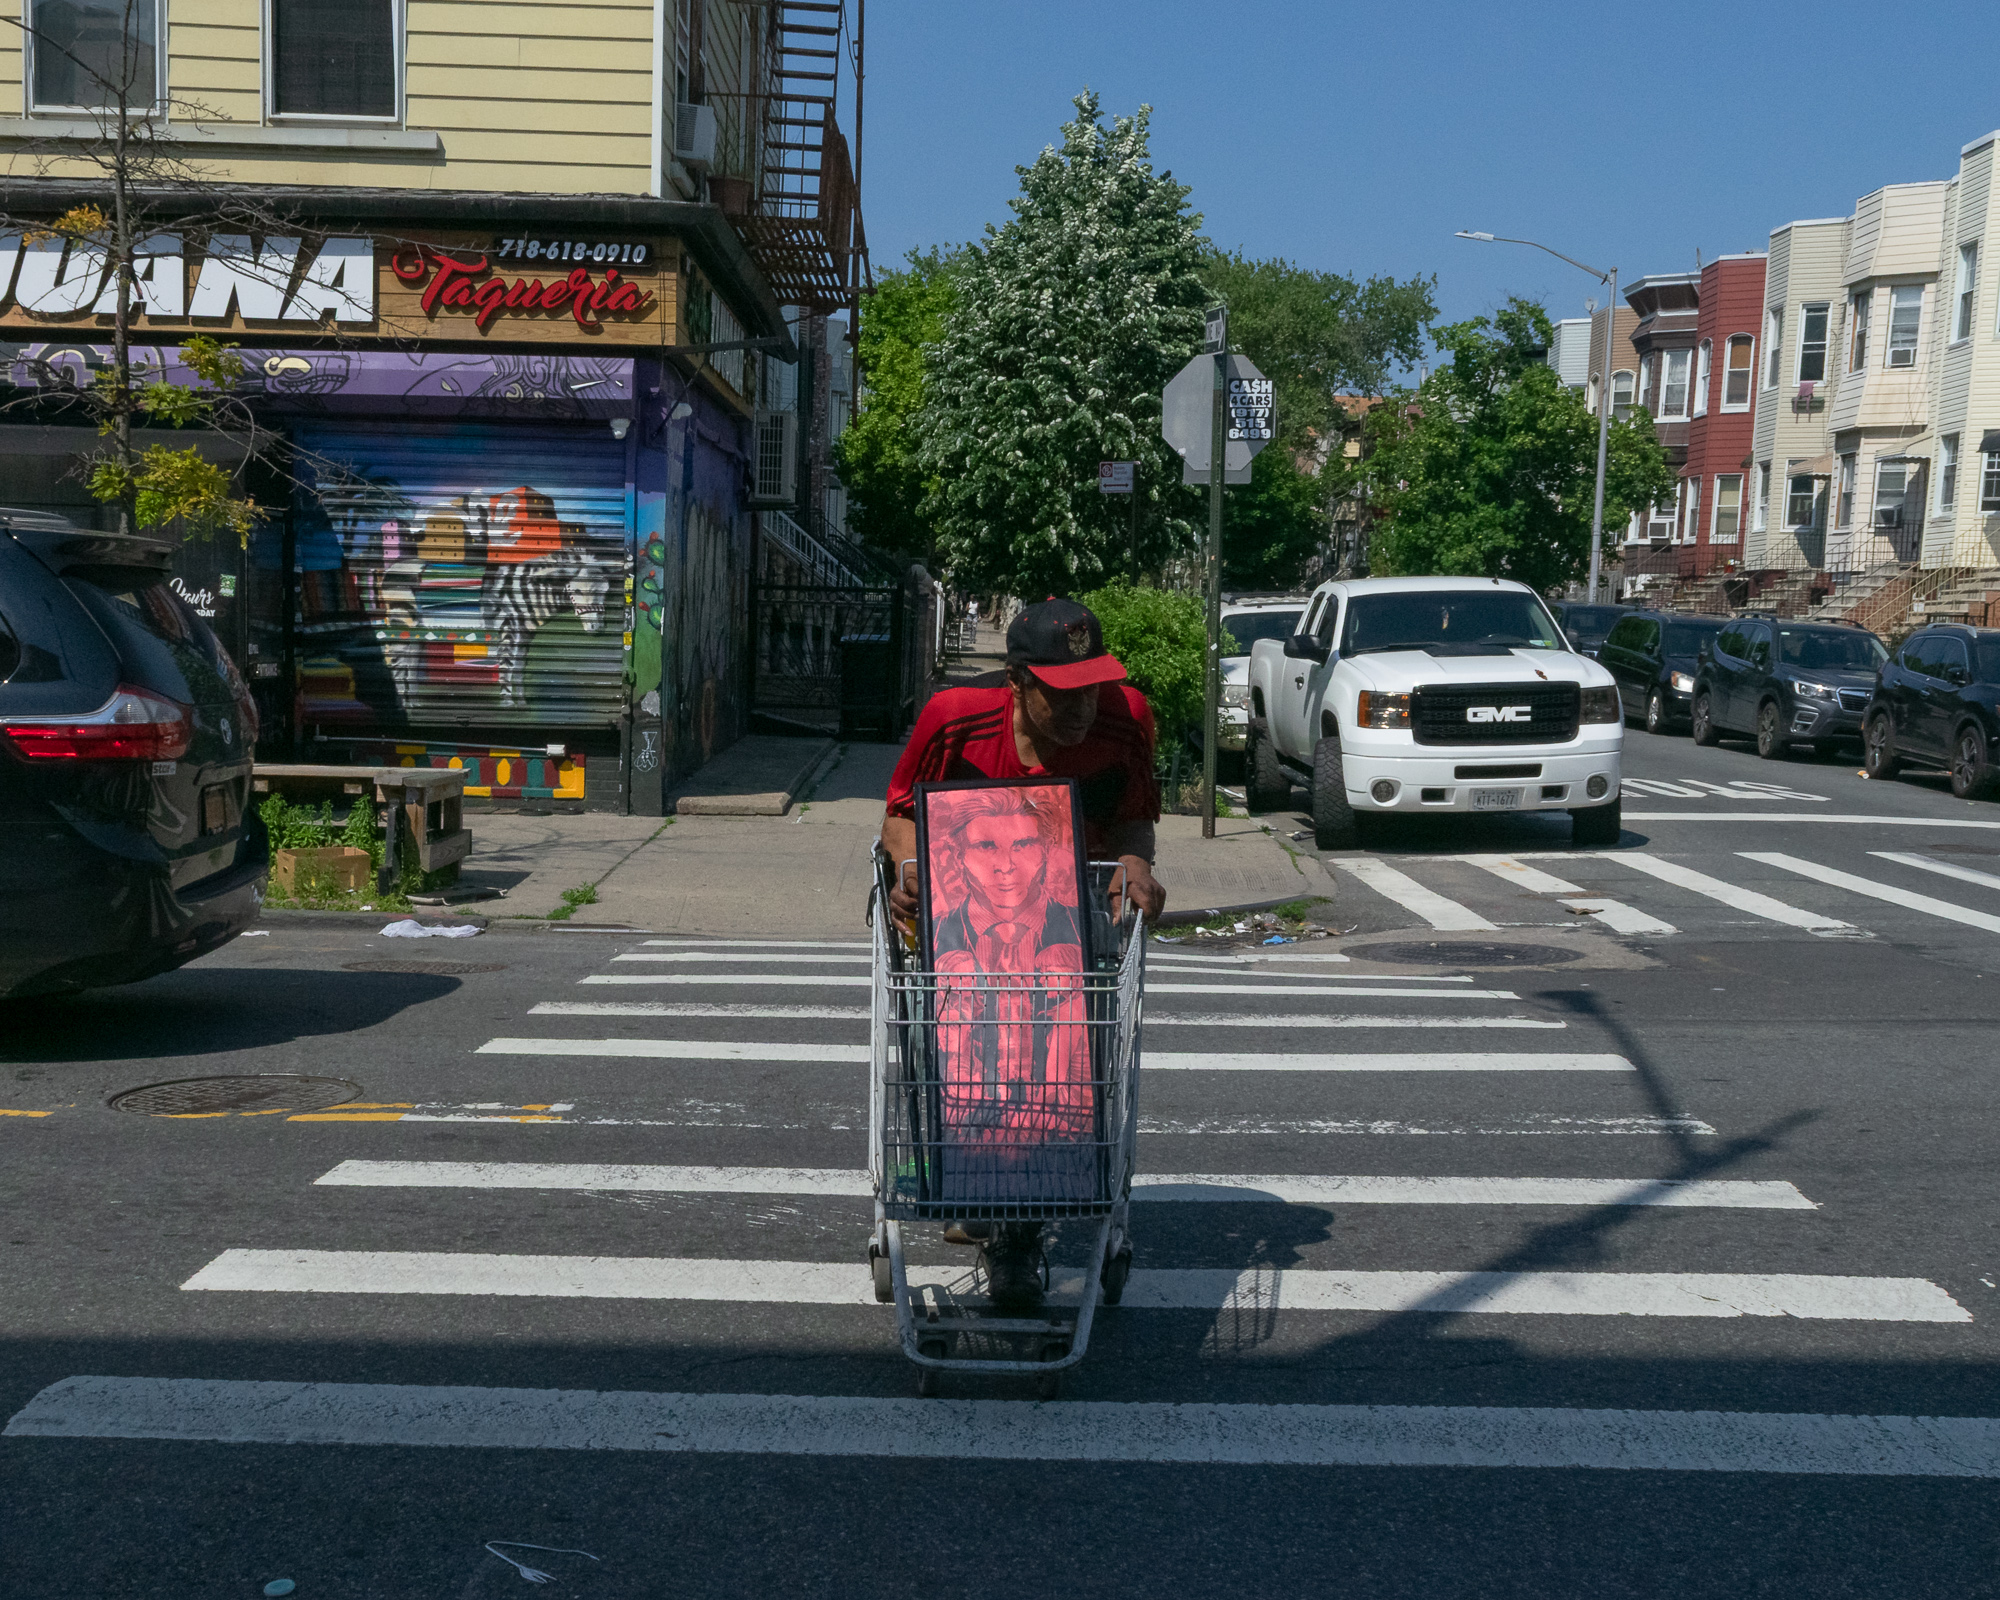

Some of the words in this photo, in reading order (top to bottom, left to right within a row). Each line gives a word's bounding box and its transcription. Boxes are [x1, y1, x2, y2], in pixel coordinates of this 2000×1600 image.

[500, 238, 647, 264] 718-618-0910
[0, 227, 374, 322] UANA
[391, 254, 653, 327] Taqueria
[1229, 378, 1273, 394] CA$H
[1231, 396, 1238, 406] 4
[1240, 394, 1271, 407] CAR$
[1230, 408, 1270, 418] (917)
[1235, 417, 1266, 428] 515
[1228, 428, 1271, 439] 6499
[1466, 705, 1532, 723] GMC
[1621, 777, 1832, 801] STO
